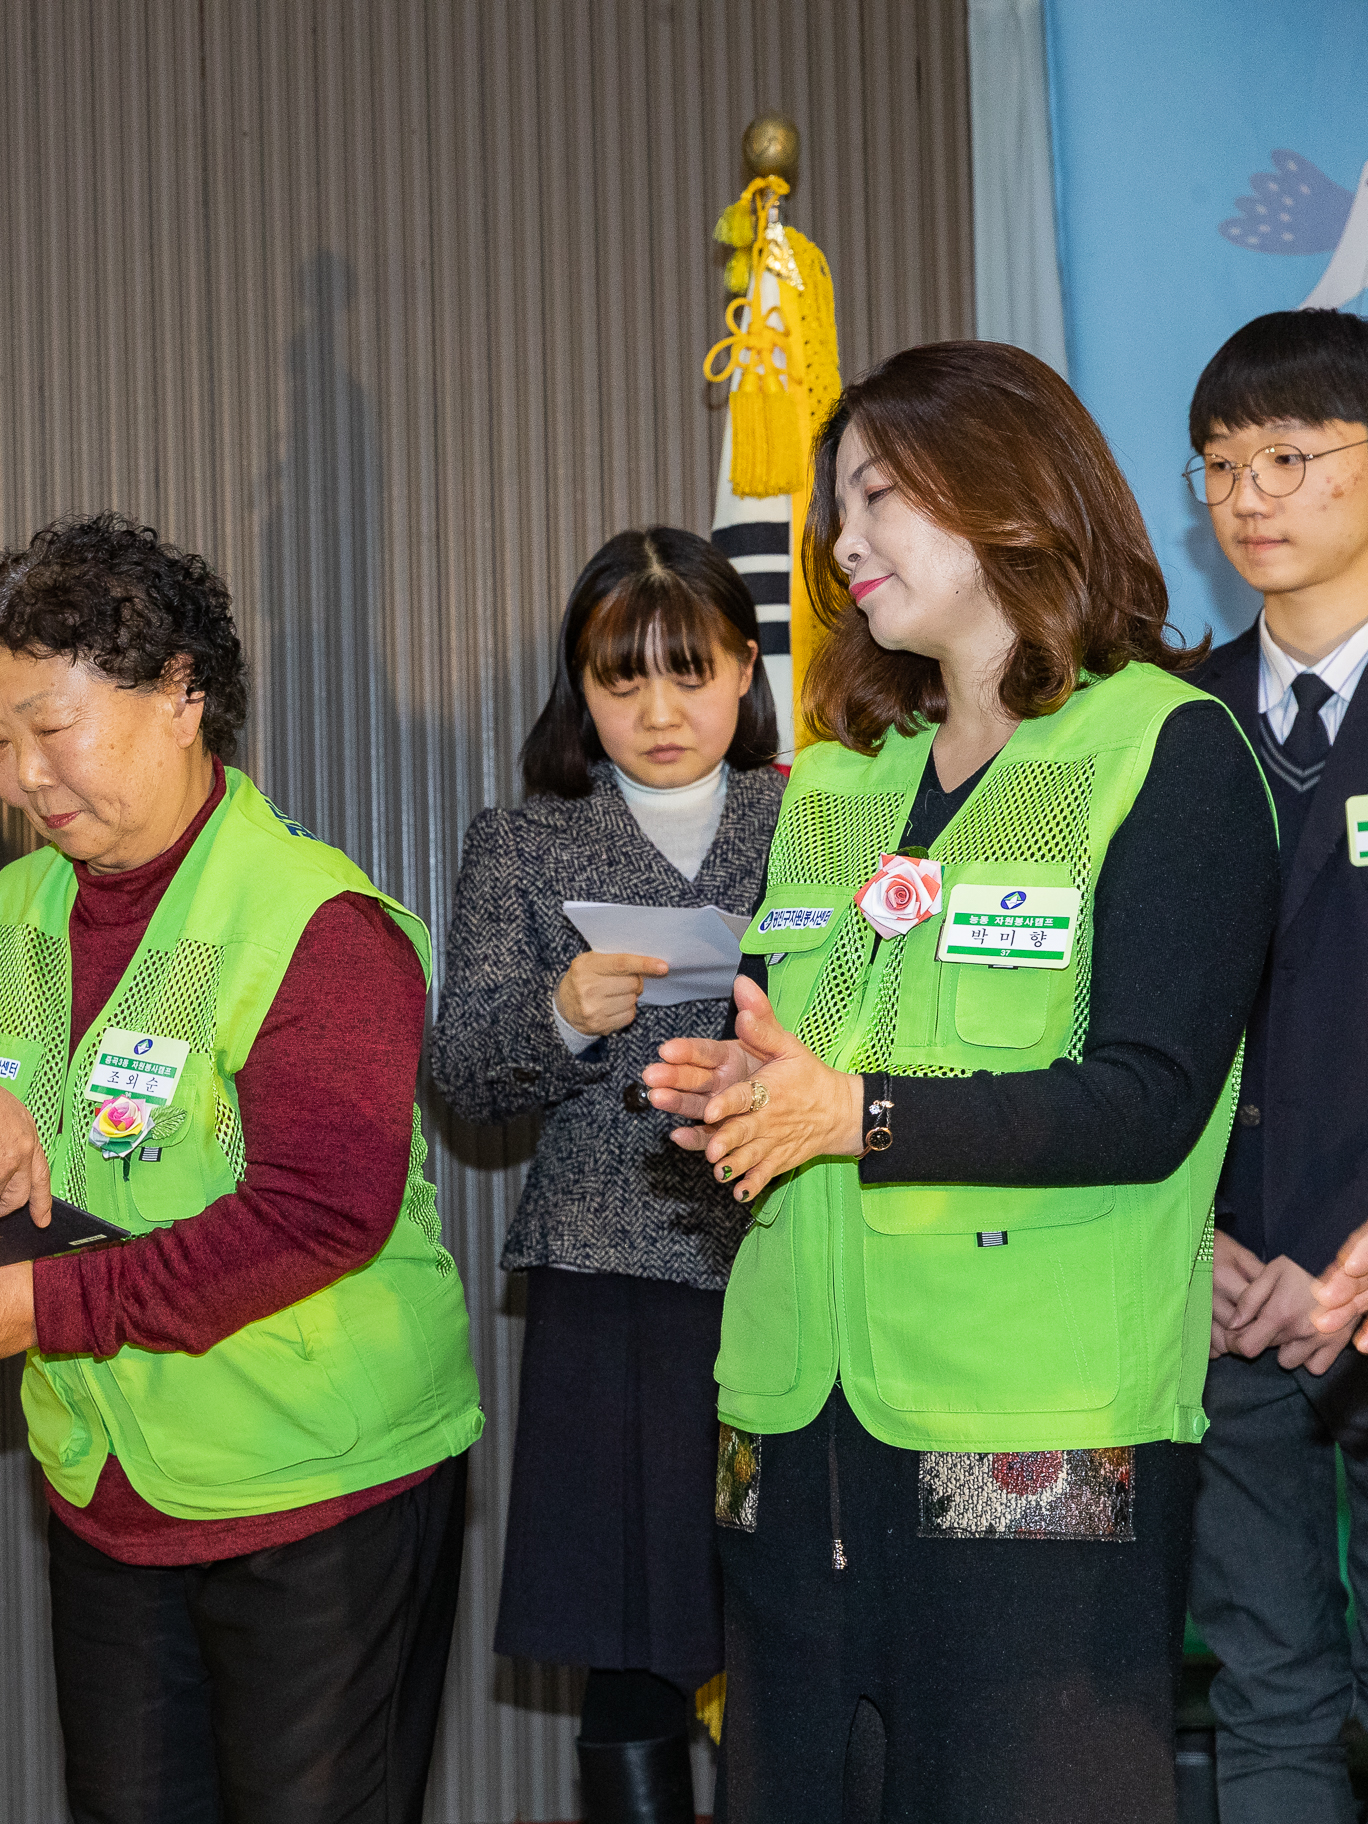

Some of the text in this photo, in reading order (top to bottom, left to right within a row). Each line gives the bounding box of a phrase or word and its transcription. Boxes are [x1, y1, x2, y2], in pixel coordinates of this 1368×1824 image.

[772, 909, 834, 928] 광진구자원봉사센터
[969, 915, 1054, 927] 능동 자원봉사캠프
[1000, 949, 1011, 957] 37
[104, 1055, 172, 1076] 중곡3동 자원봉사캠프
